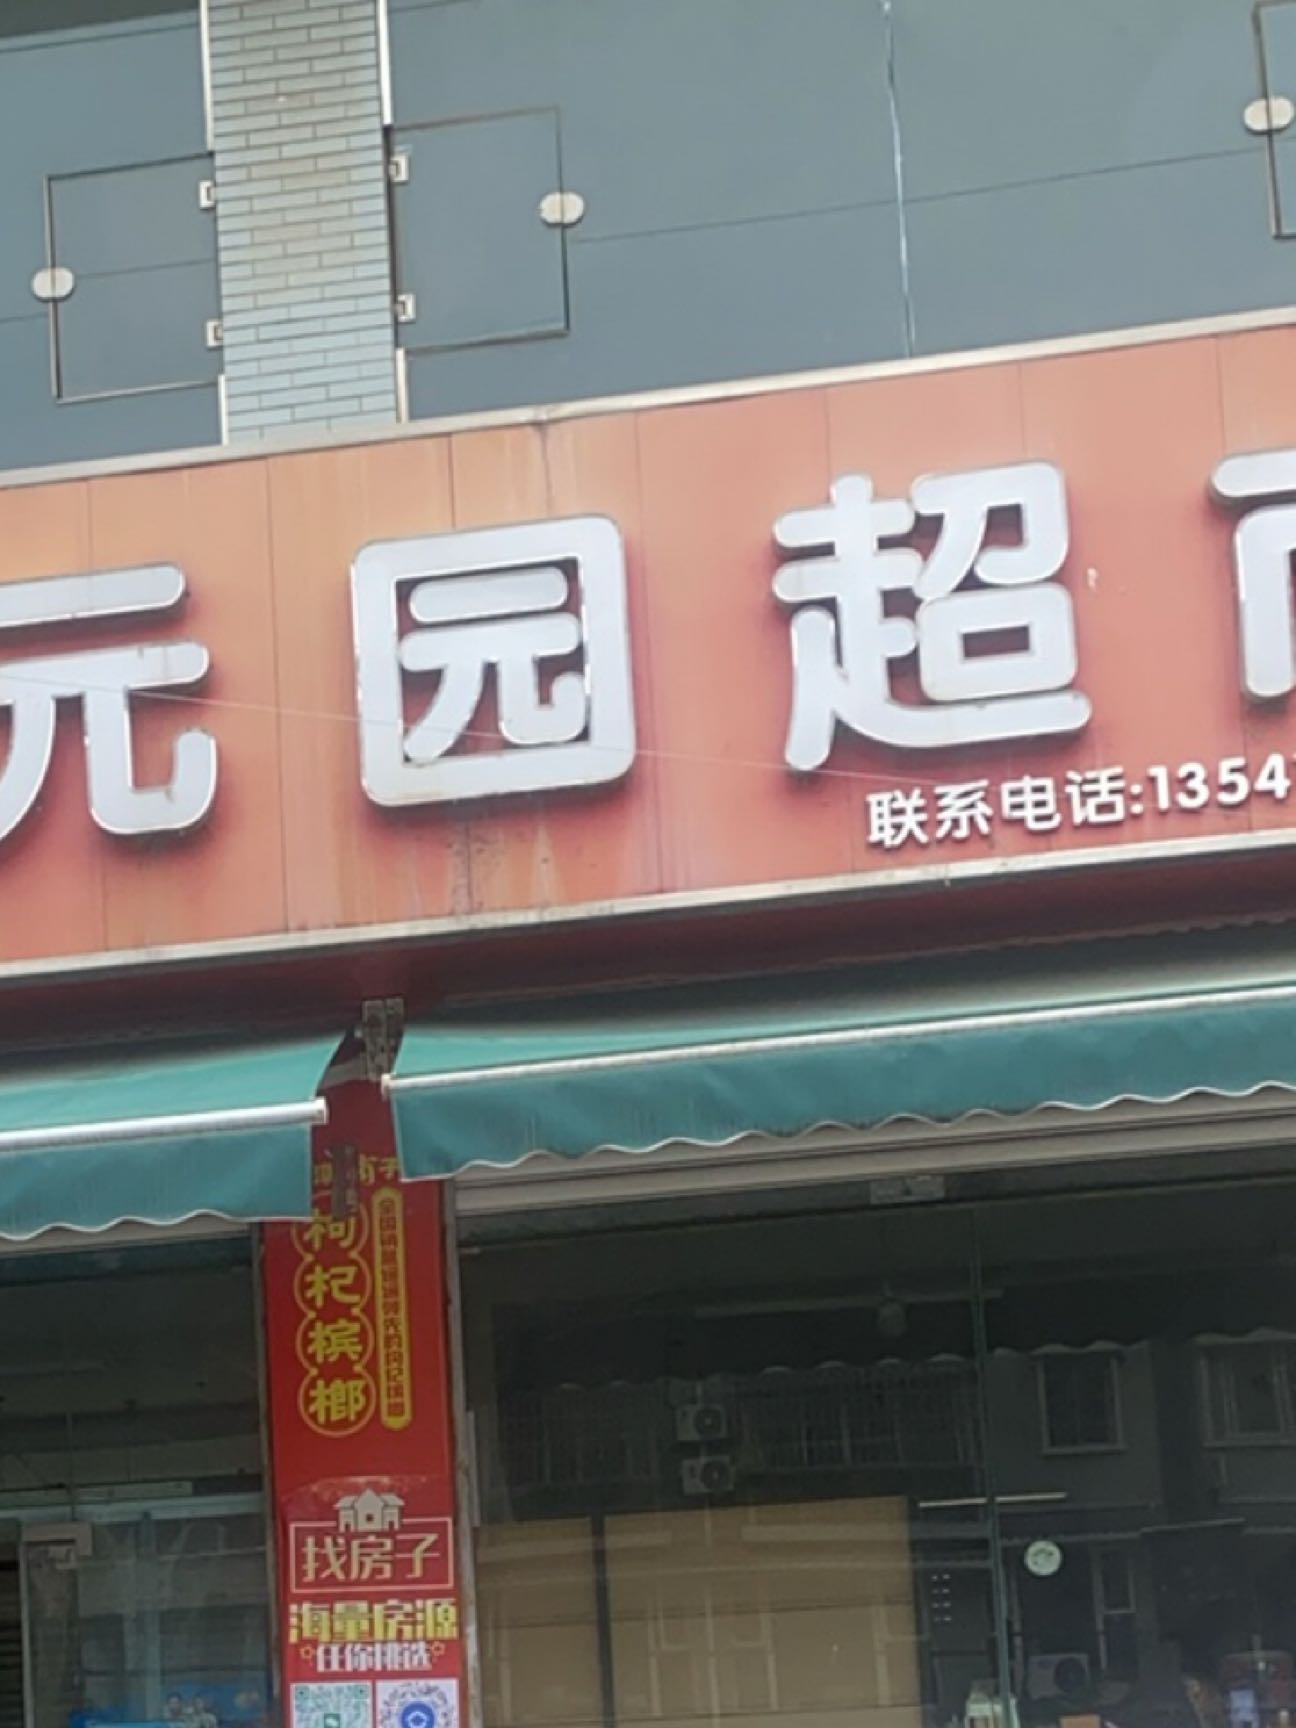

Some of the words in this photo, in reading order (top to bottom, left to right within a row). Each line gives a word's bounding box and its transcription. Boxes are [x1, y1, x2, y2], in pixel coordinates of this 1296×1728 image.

[865, 752, 1296, 850] 联系电话:1354
[301, 1532, 441, 1583] 找房子
[288, 1599, 459, 1645] 海量房源
